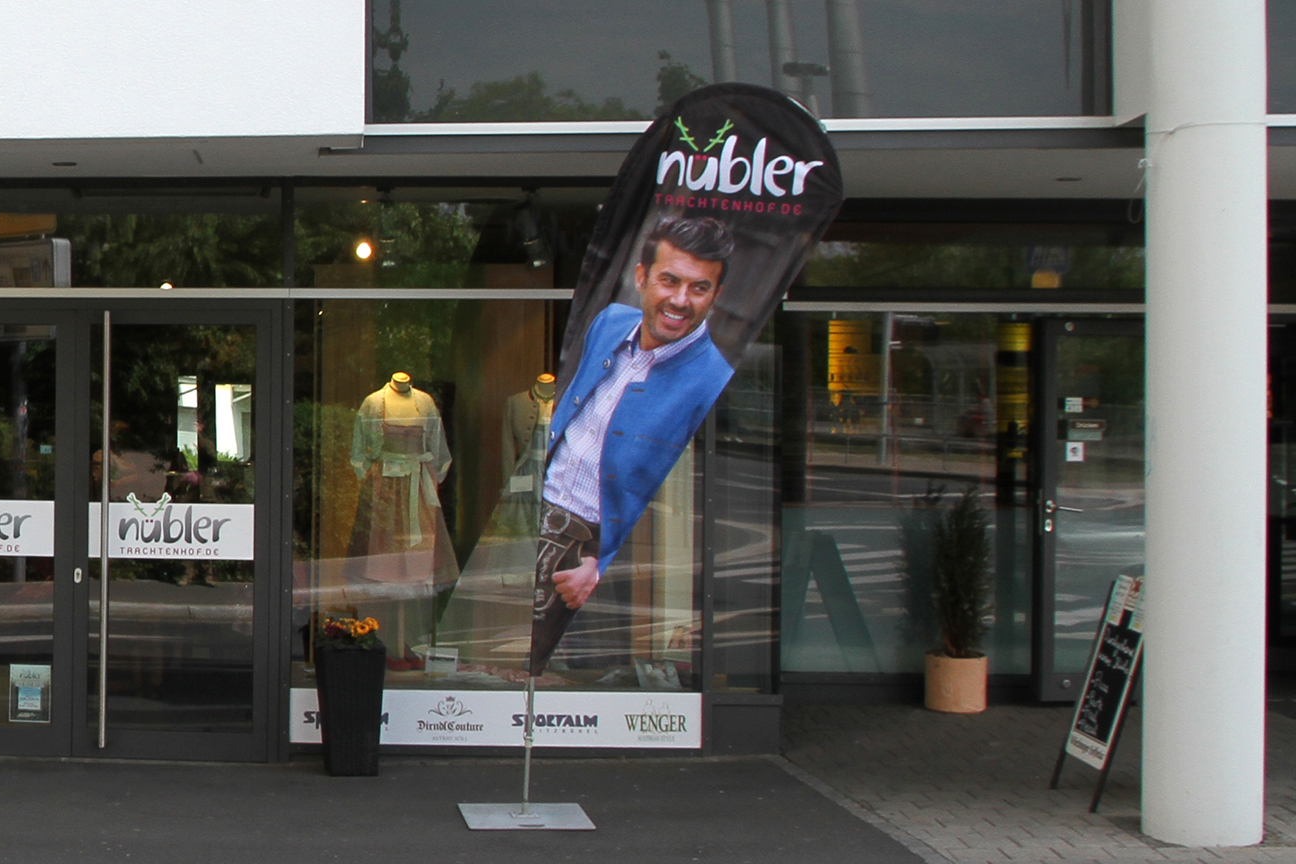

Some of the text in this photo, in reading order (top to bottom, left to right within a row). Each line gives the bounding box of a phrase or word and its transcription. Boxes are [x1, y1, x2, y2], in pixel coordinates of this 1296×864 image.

[656, 134, 824, 197] nübler
[118, 505, 232, 544] nübler
[120, 546, 220, 557] TRACHTENHOF.DE
[624, 714, 687, 733] WENGER
